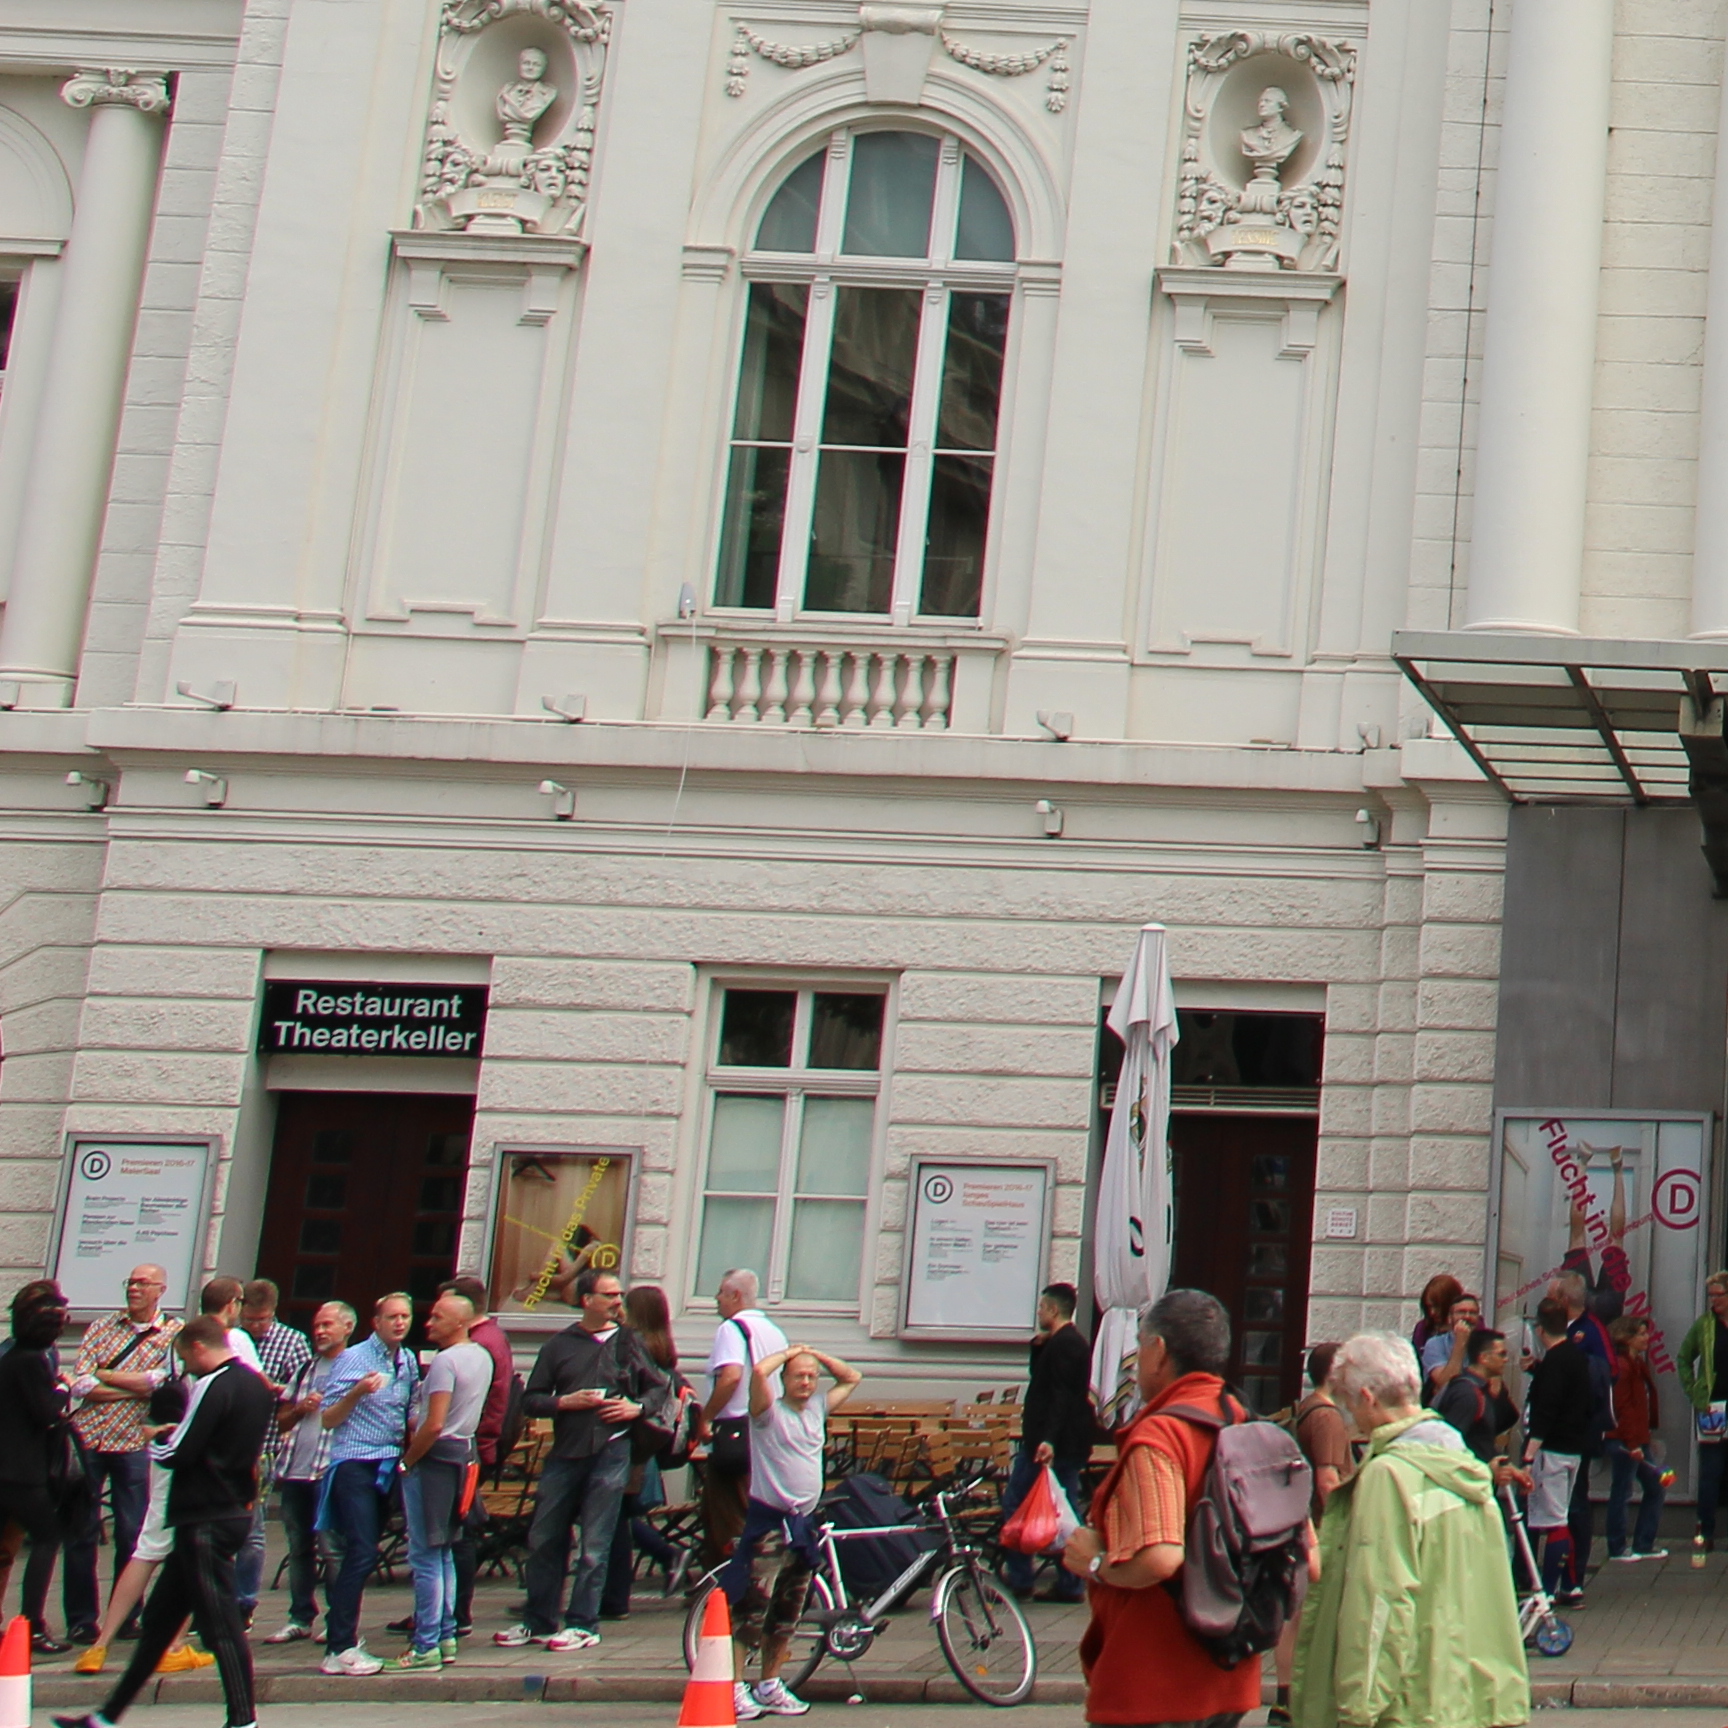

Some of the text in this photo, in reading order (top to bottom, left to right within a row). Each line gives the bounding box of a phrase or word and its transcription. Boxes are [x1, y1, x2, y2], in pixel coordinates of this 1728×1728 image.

[273, 1021, 477, 1051] Theaterkeller
[295, 989, 462, 1018] Restaurant
[523, 1260, 559, 1311] Flucht
[561, 1213, 583, 1241] das
[574, 1156, 611, 1210] Private
[1538, 1118, 1677, 1374] Flucht in die Ntur
